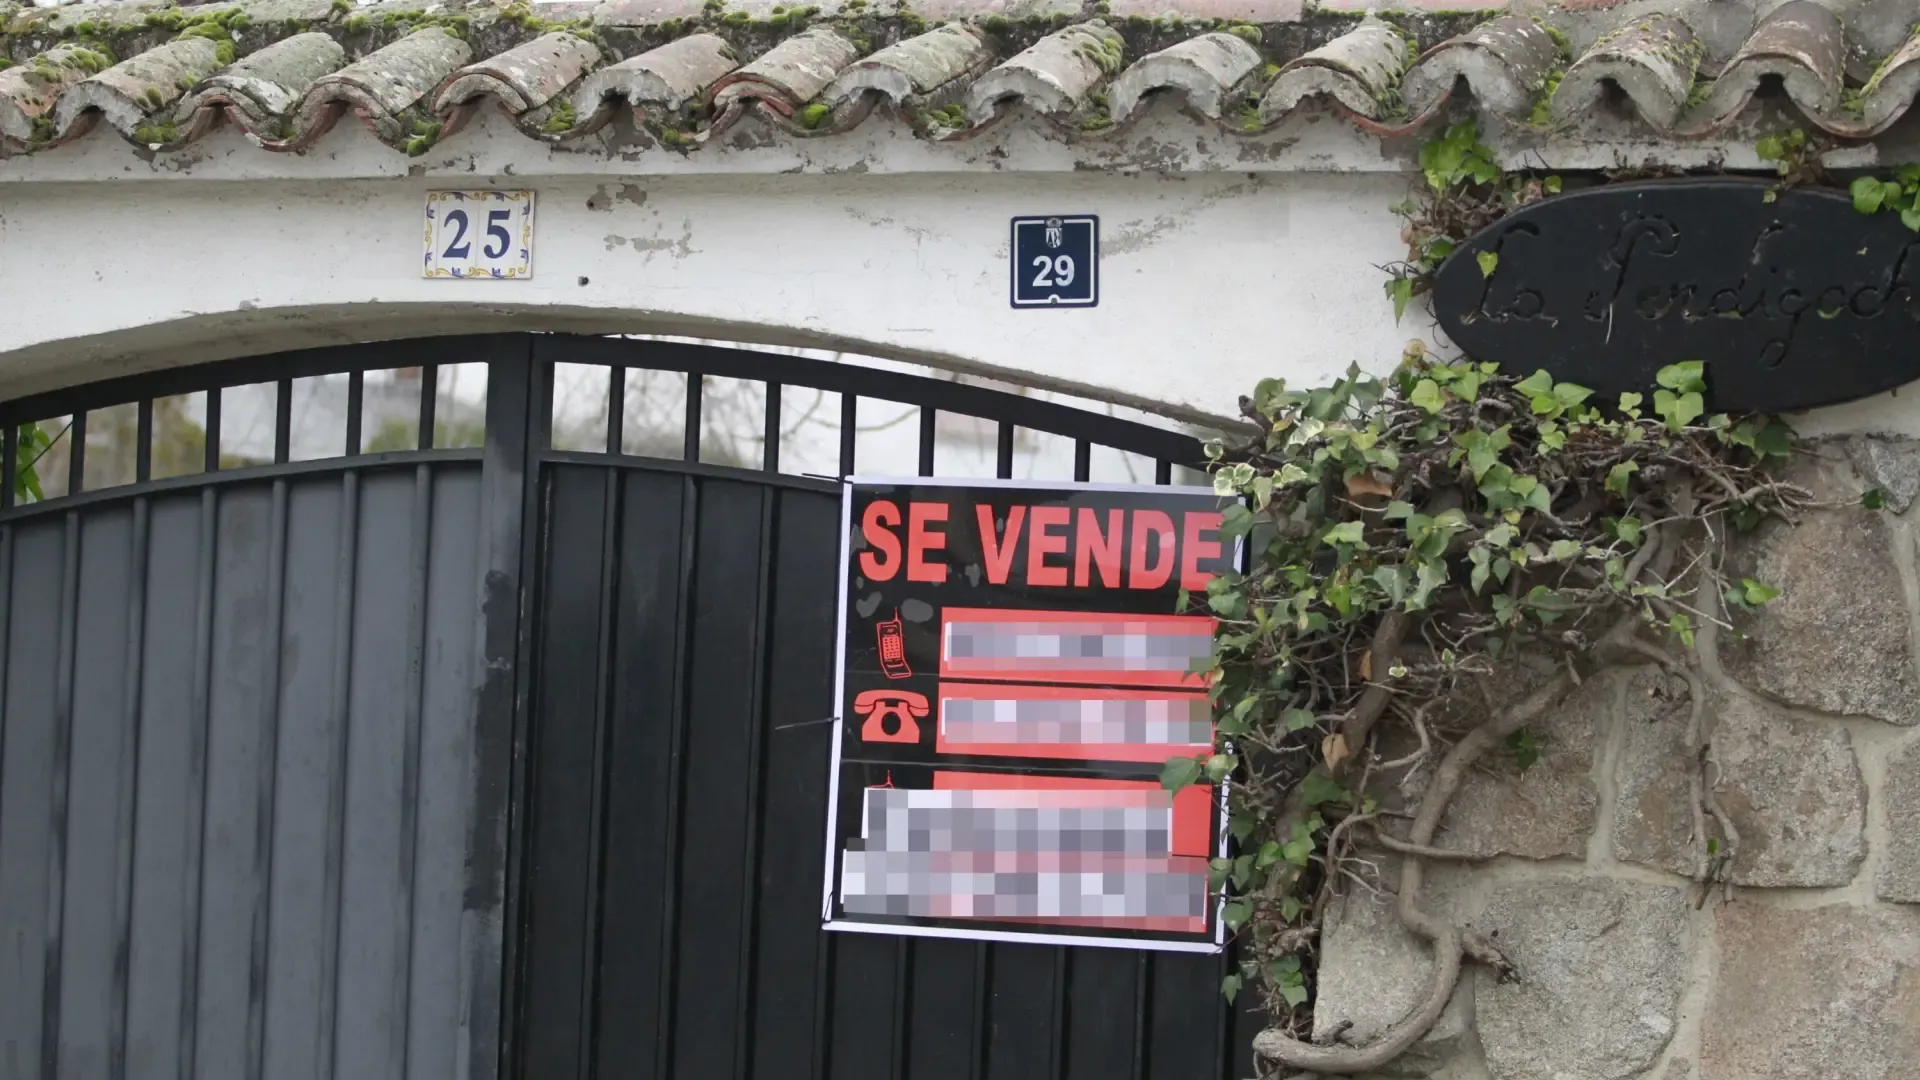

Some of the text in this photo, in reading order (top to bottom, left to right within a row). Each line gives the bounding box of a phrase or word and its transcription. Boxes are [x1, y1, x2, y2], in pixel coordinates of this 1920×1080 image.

[442, 208, 511, 260] 25
[1032, 254, 1075, 287] 29
[859, 499, 1225, 592] SE VENDE
